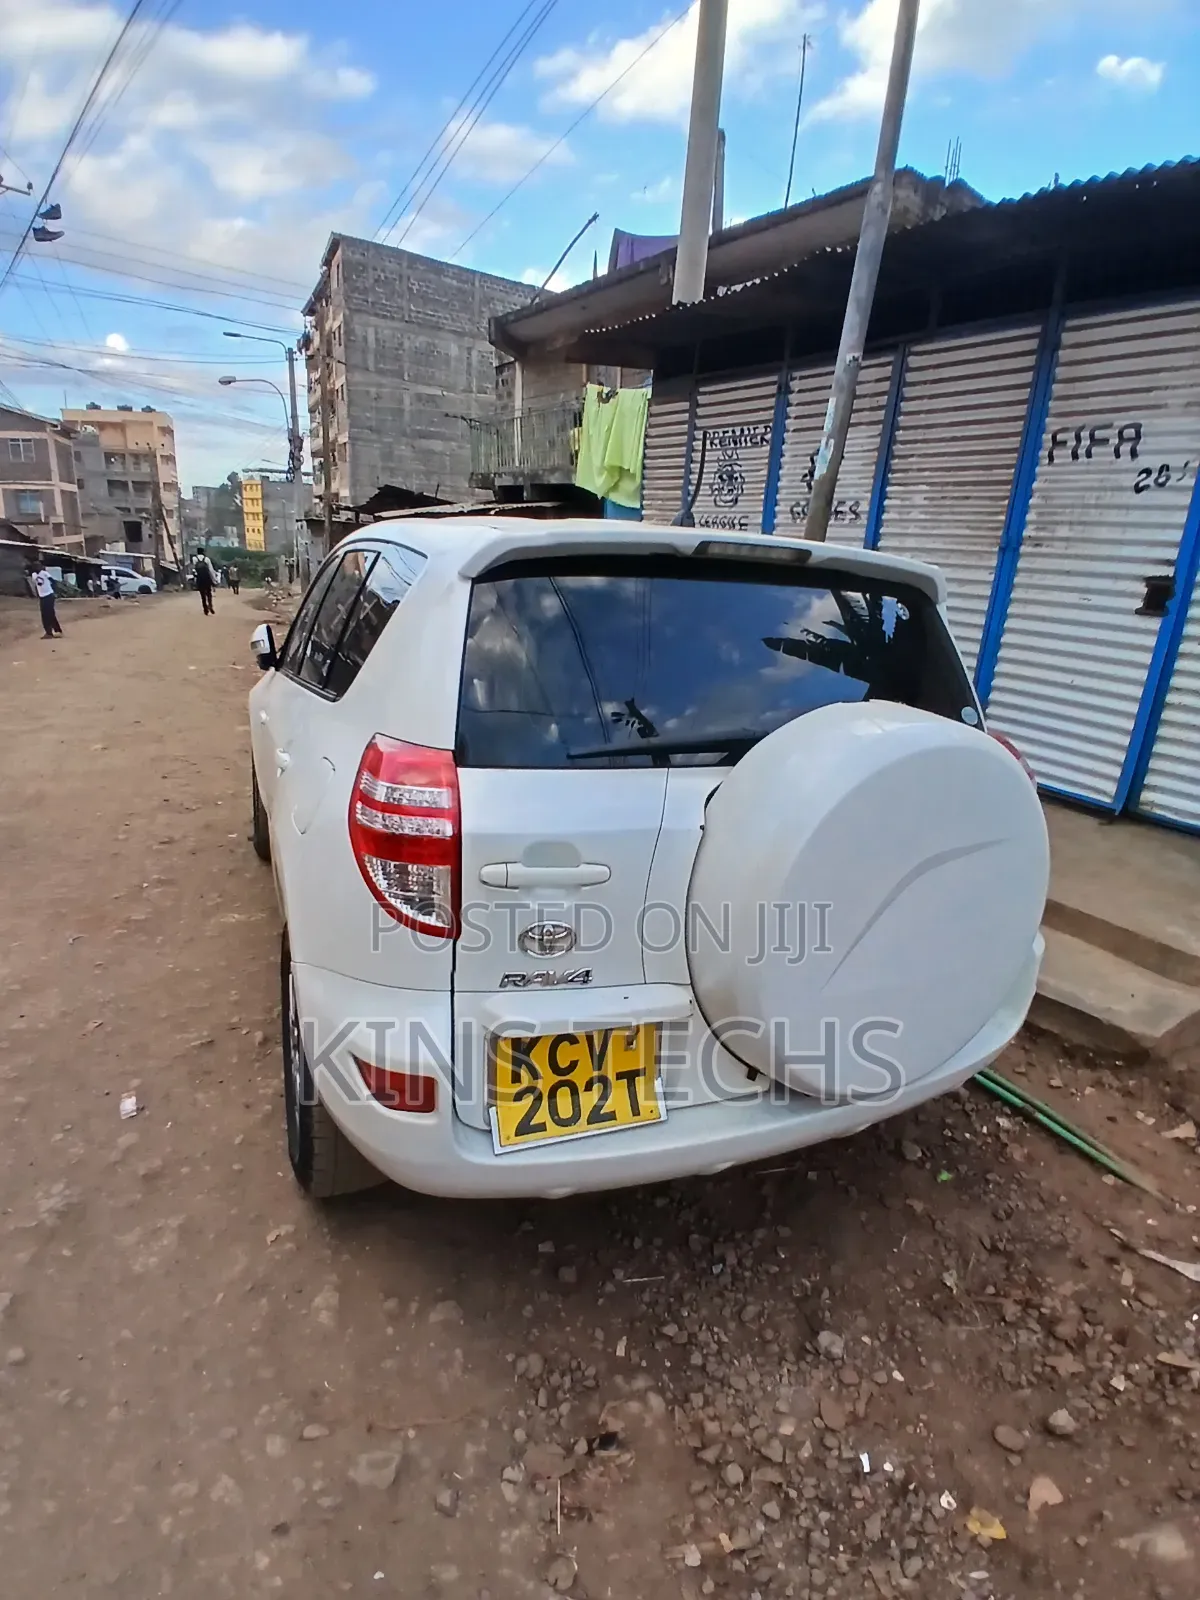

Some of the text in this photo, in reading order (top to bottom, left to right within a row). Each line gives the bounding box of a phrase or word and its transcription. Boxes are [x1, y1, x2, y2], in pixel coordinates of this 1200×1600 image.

[1047, 422, 1142, 465] FIFA
[699, 514, 749, 531] LEAGUE
[499, 967, 593, 988] RAV4
[510, 1027, 614, 1085] KCV
[512, 1068, 647, 1138] 202T
